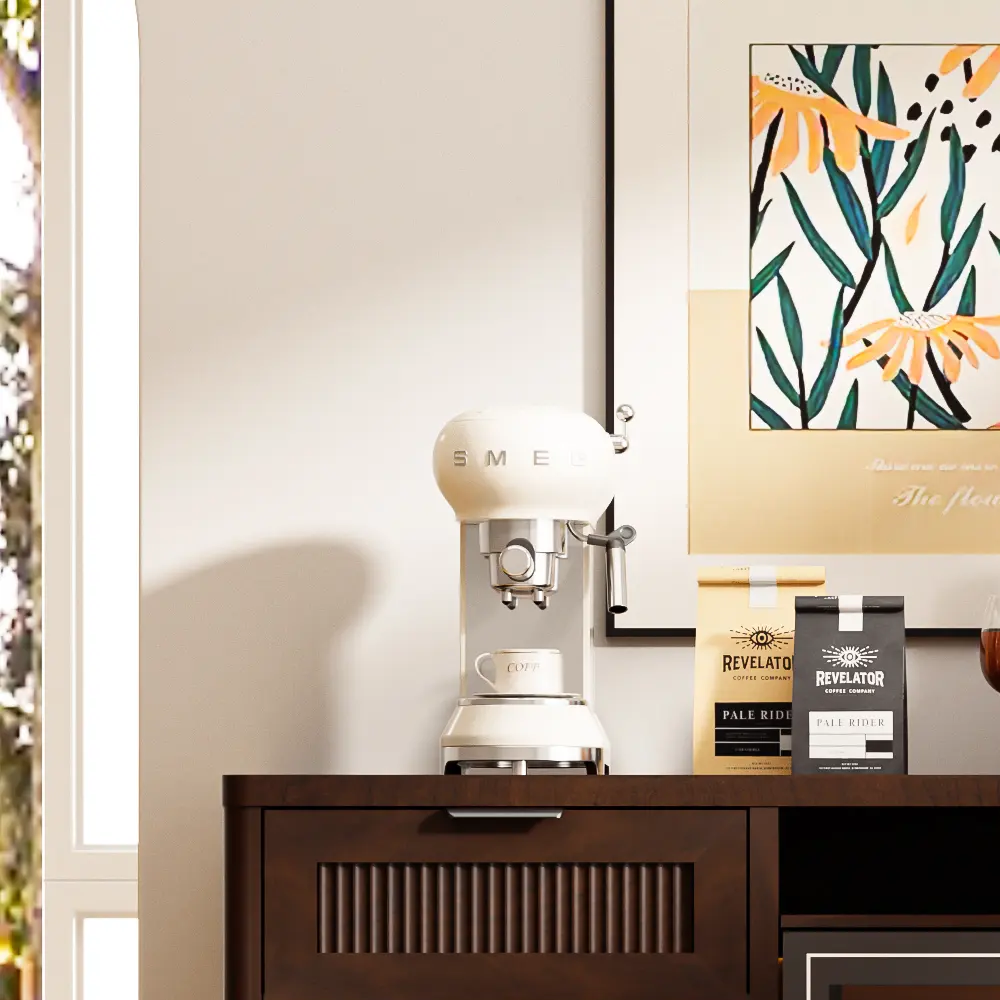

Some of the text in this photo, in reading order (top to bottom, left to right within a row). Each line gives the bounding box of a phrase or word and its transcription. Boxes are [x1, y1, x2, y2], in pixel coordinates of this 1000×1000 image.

[722, 654, 794, 672] REVELATO
[815, 670, 885, 688] REVELATOR
[722, 710, 756, 720] PALE
[816, 718, 885, 727] PALE RIDER
